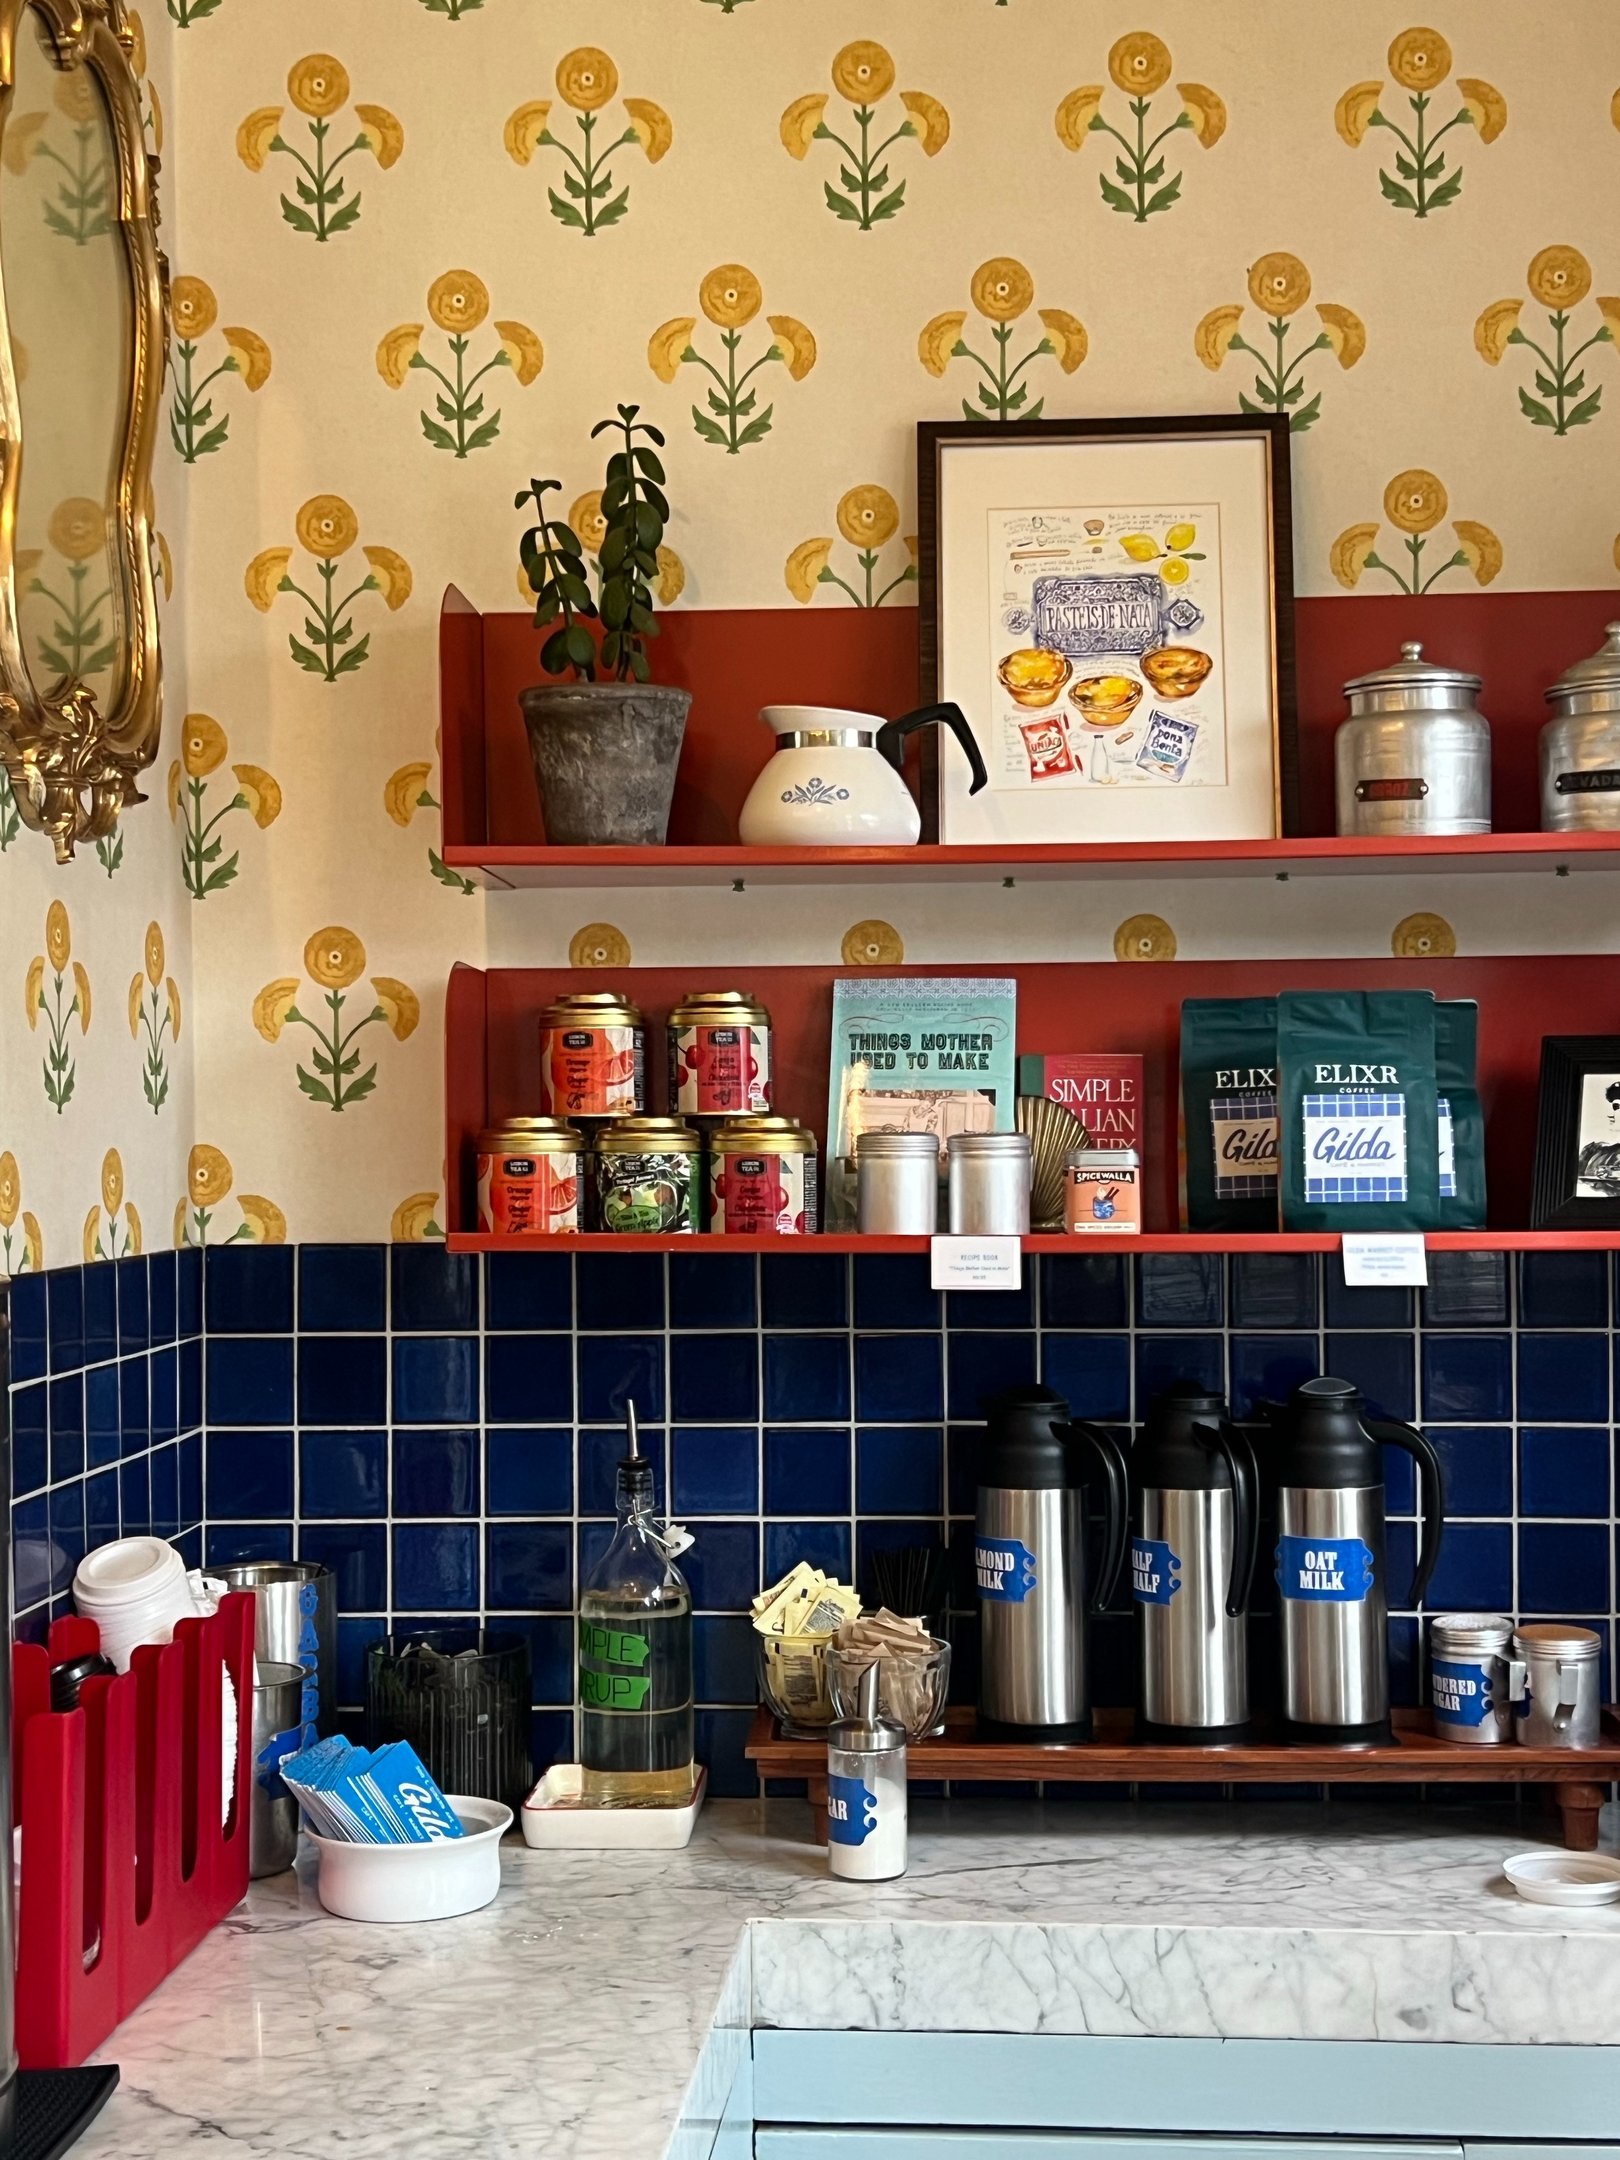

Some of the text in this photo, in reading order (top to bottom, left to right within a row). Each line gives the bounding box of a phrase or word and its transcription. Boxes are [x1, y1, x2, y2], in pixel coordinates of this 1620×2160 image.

[1120, 602, 1153, 628] NATA
[849, 1033, 993, 1051] THINGS MOTHER
[851, 1053, 990, 1070] USED TO MAKE
[1215, 1068, 1277, 1089] ELIX
[1315, 1064, 1400, 1084] ELIXR
[1049, 1078, 1135, 1103] SIMPLE
[1071, 1108, 1136, 1132] LIAN
[1312, 1126, 1397, 1163] Gilda
[975, 1547, 1015, 1572] LMOND
[1304, 1550, 1338, 1571] OAT
[1298, 1570, 1345, 1591] MILK
[584, 1671, 632, 1703] RUP
